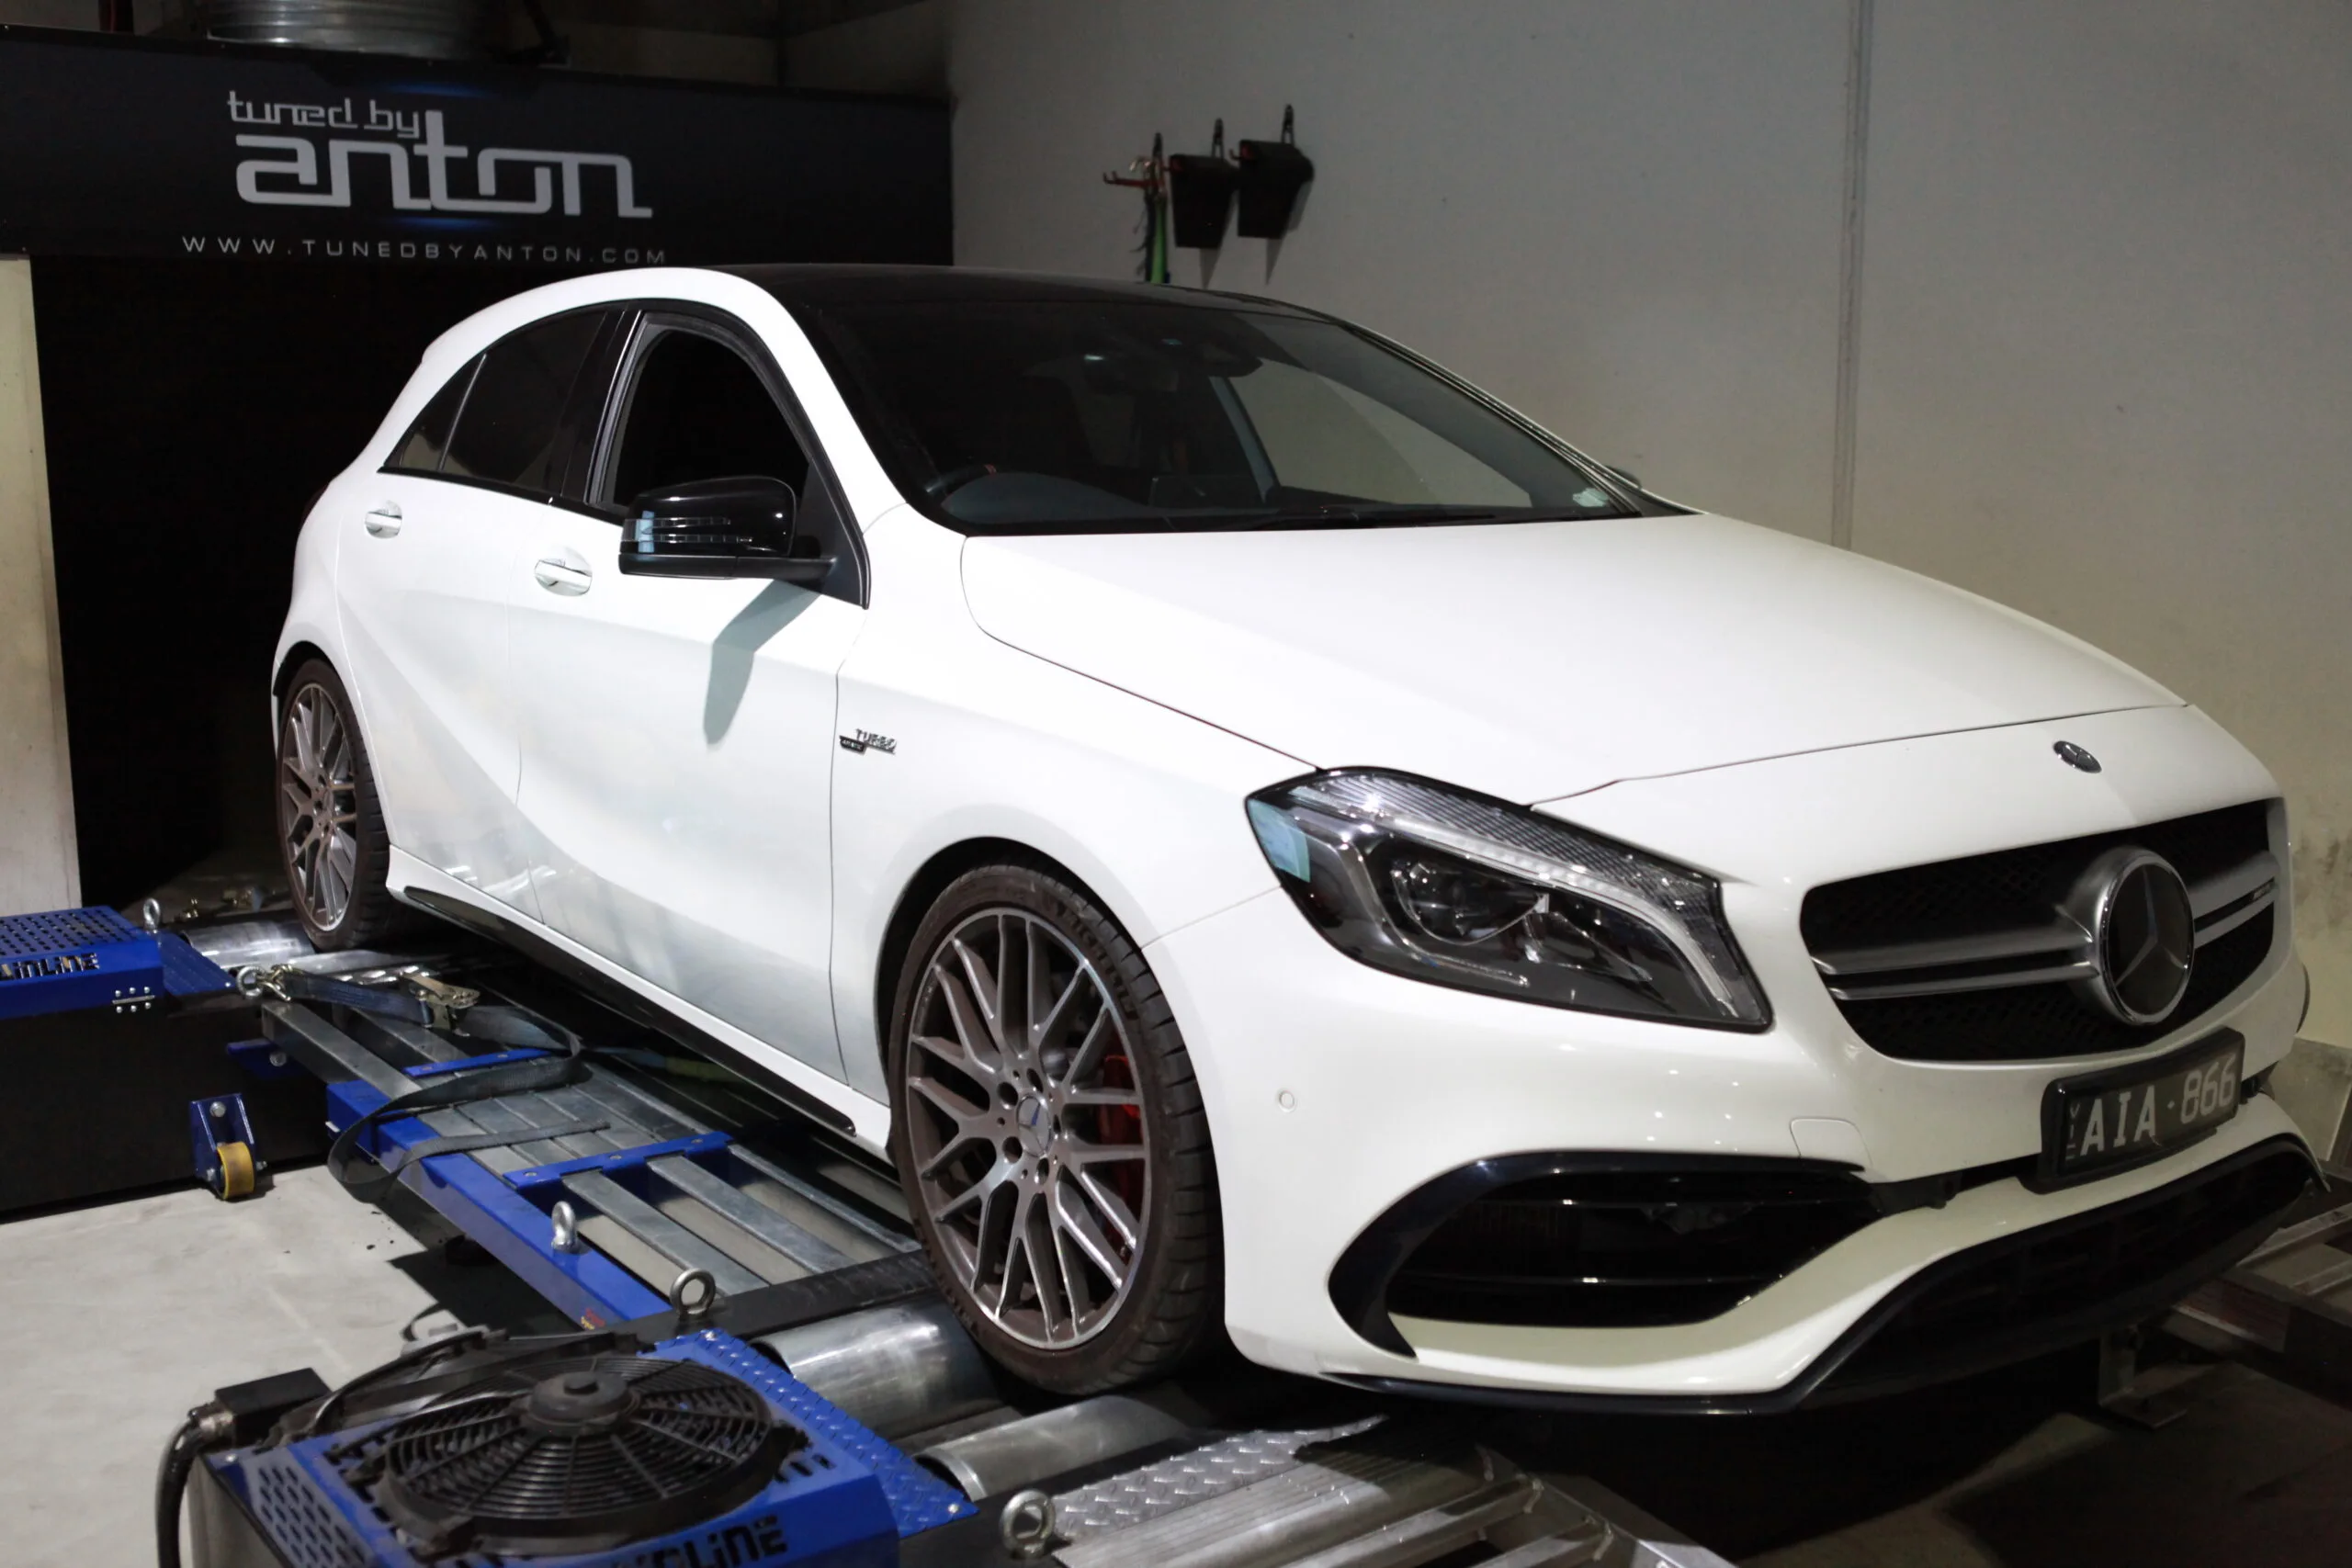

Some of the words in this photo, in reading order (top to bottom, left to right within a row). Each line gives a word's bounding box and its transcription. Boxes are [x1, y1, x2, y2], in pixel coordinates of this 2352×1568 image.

[227, 90, 358, 129] tuned
[364, 99, 420, 139] by
[235, 111, 653, 218] anton
[182, 236, 665, 264] WWW.TUNEDBYANTON.COM
